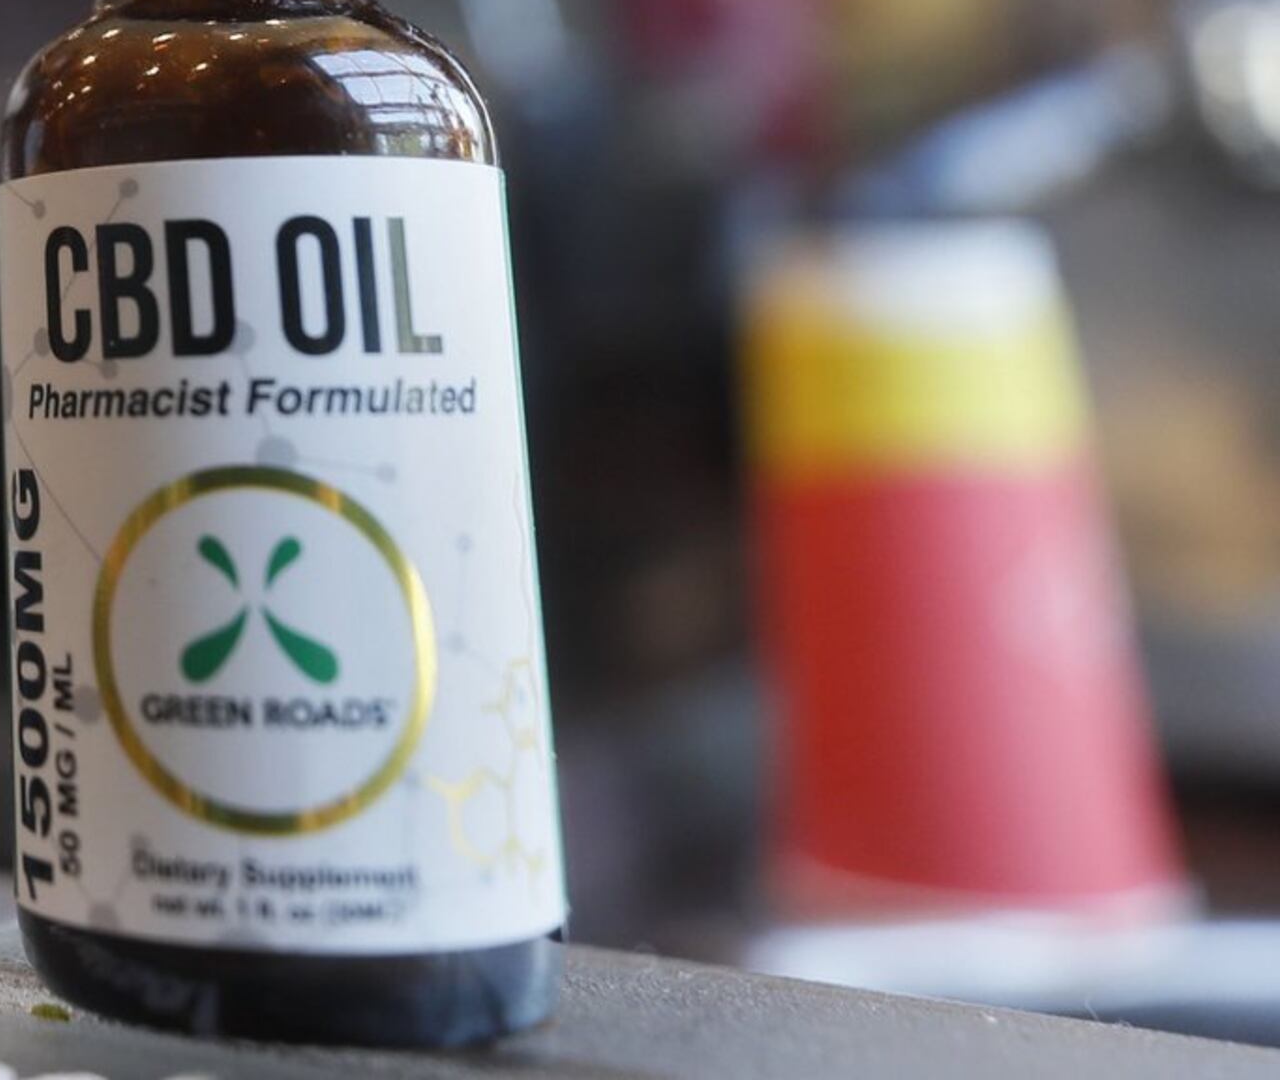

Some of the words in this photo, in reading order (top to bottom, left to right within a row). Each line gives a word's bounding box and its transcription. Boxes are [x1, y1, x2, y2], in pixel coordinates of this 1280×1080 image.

[44, 218, 236, 363] CBD
[276, 215, 443, 356] OIL
[28, 378, 231, 419] Pharmacist
[246, 376, 477, 416] Formulated
[11, 467, 55, 901] 1500MG
[52, 652, 74, 708] ML
[141, 693, 252, 729] GREEN
[262, 696, 388, 731] ROADS
[55, 750, 79, 818] MG
[60, 829, 81, 878] 50
[132, 848, 229, 890] Dietary
[241, 856, 417, 892] Supplement
